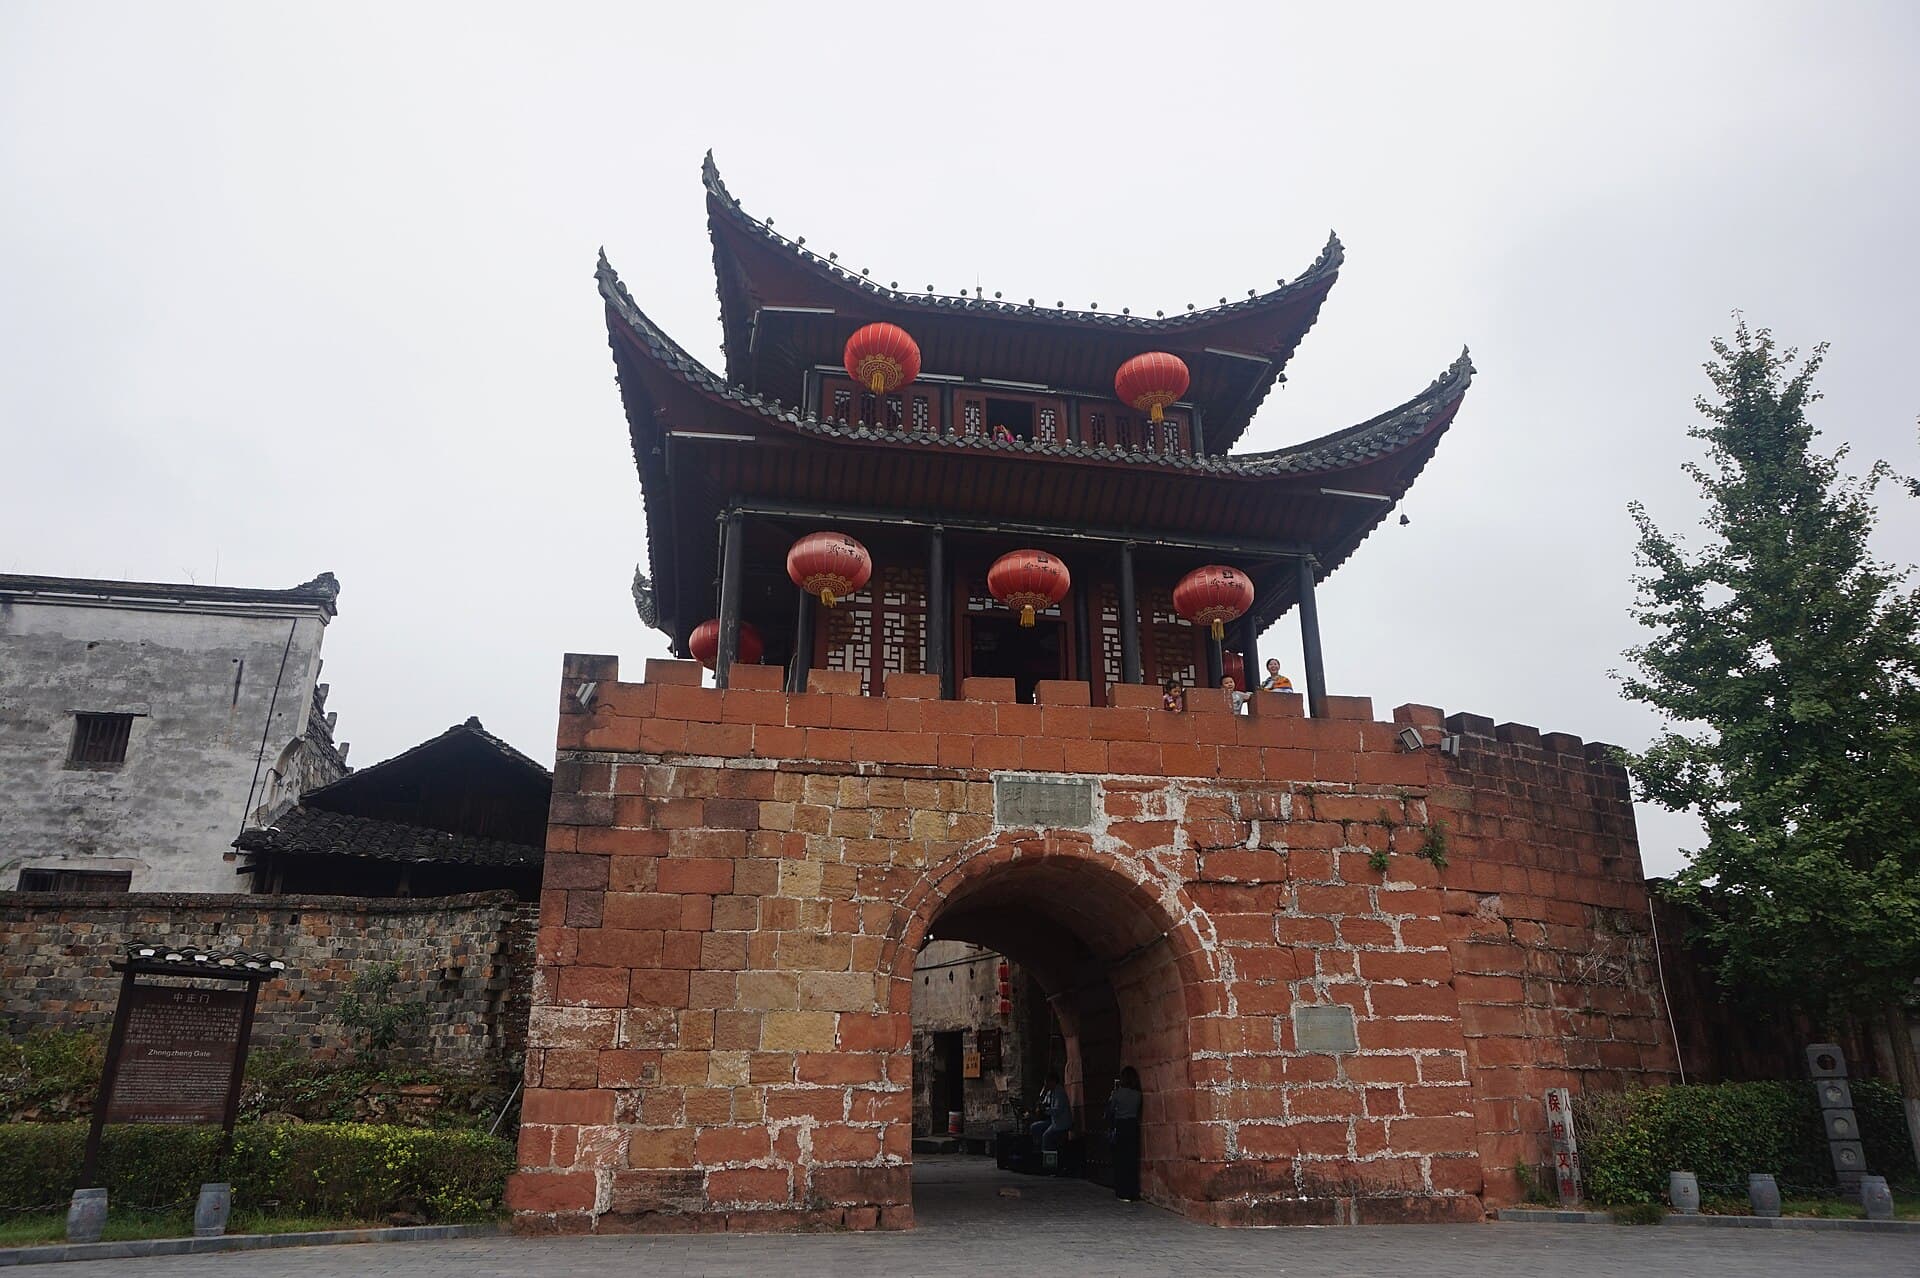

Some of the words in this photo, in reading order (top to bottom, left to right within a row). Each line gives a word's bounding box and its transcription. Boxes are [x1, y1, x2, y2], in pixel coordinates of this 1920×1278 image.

[173, 993, 210, 1004] 中正门
[148, 1049, 192, 1058] Zhongzheng
[1548, 1093, 1575, 1197] 保护文物
